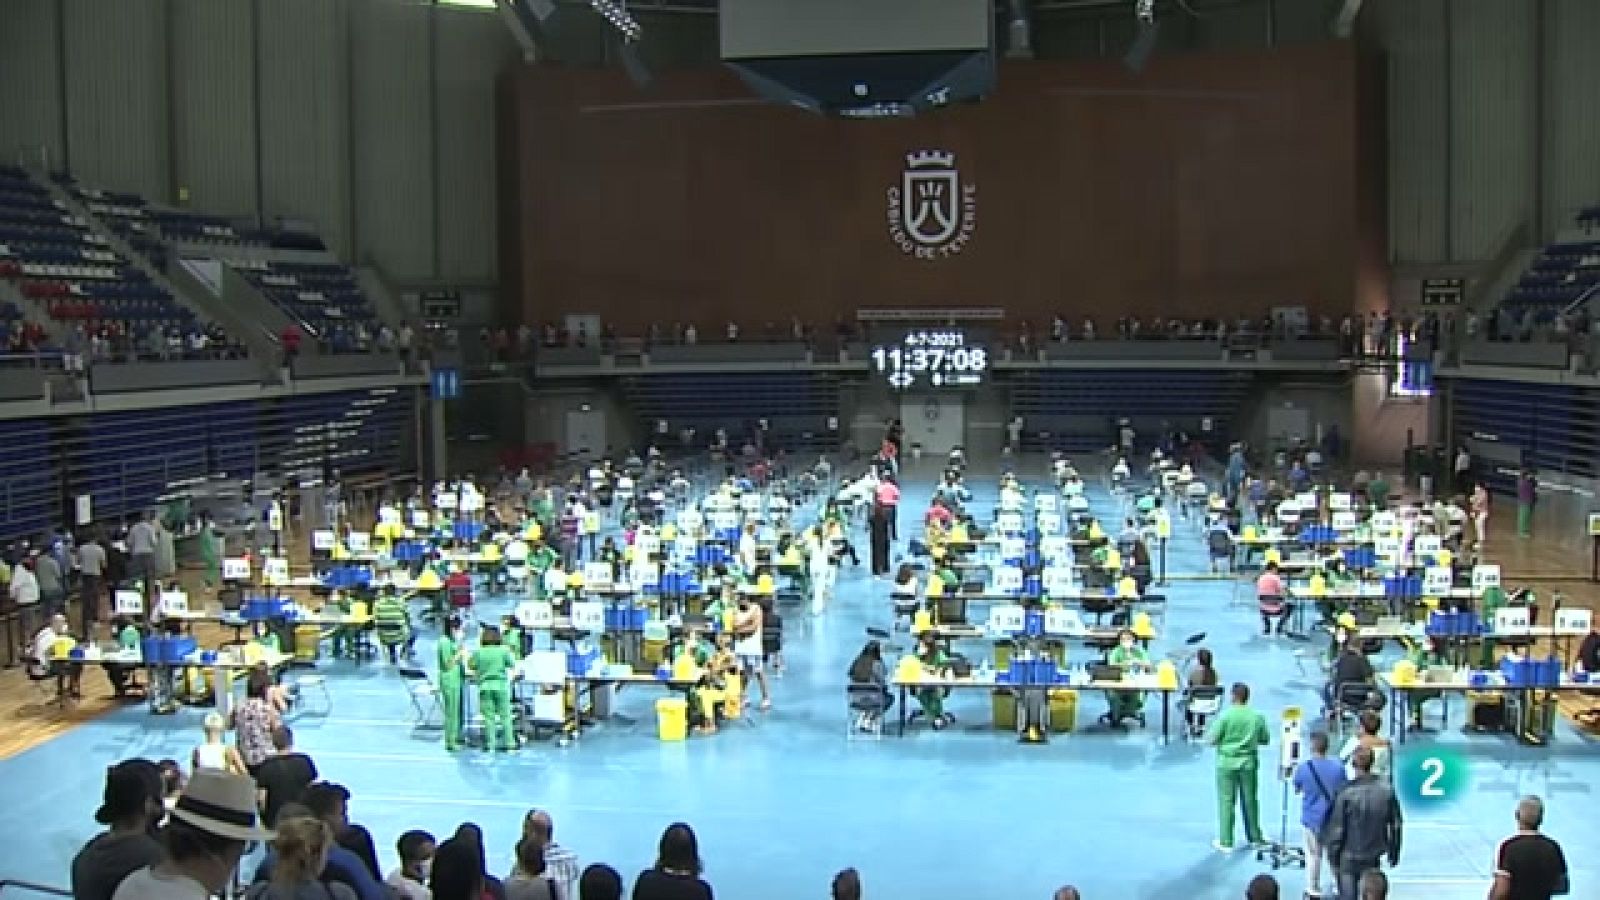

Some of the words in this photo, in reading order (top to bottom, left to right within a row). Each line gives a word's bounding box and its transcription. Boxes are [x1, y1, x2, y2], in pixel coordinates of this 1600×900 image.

[887, 186, 914, 253] CABILDO
[914, 244, 936, 259] DE
[939, 183, 976, 258] TENERIFE
[871, 347, 987, 372] 11:37:08
